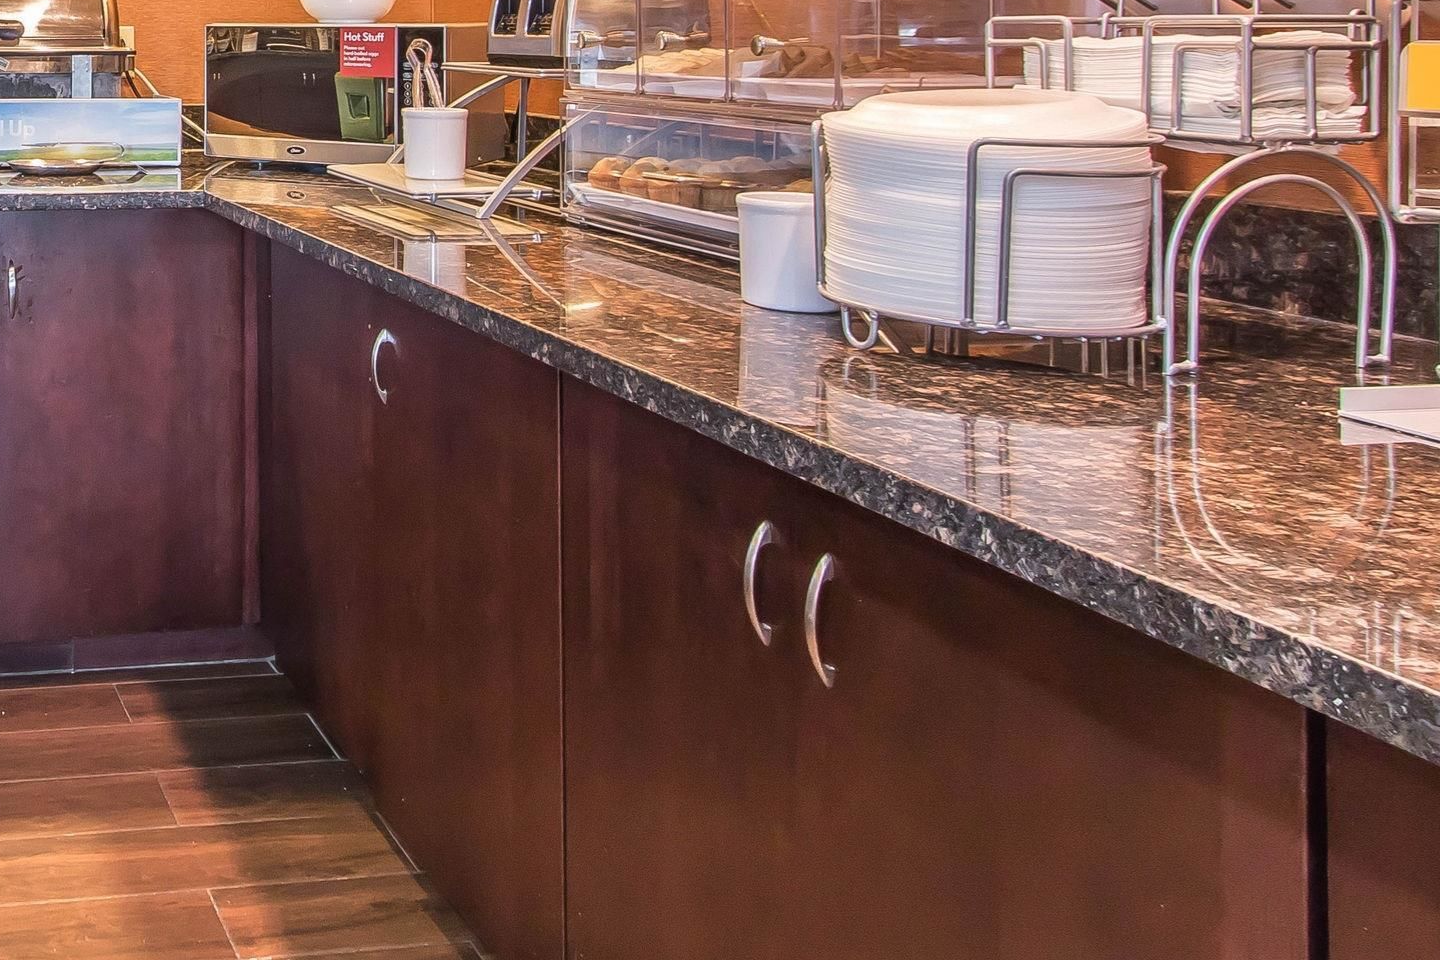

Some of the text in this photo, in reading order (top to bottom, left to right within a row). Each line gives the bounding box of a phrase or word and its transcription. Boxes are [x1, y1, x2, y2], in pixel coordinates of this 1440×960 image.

[344, 32, 385, 42] Hot Stuff
[9, 119, 36, 140] Up
